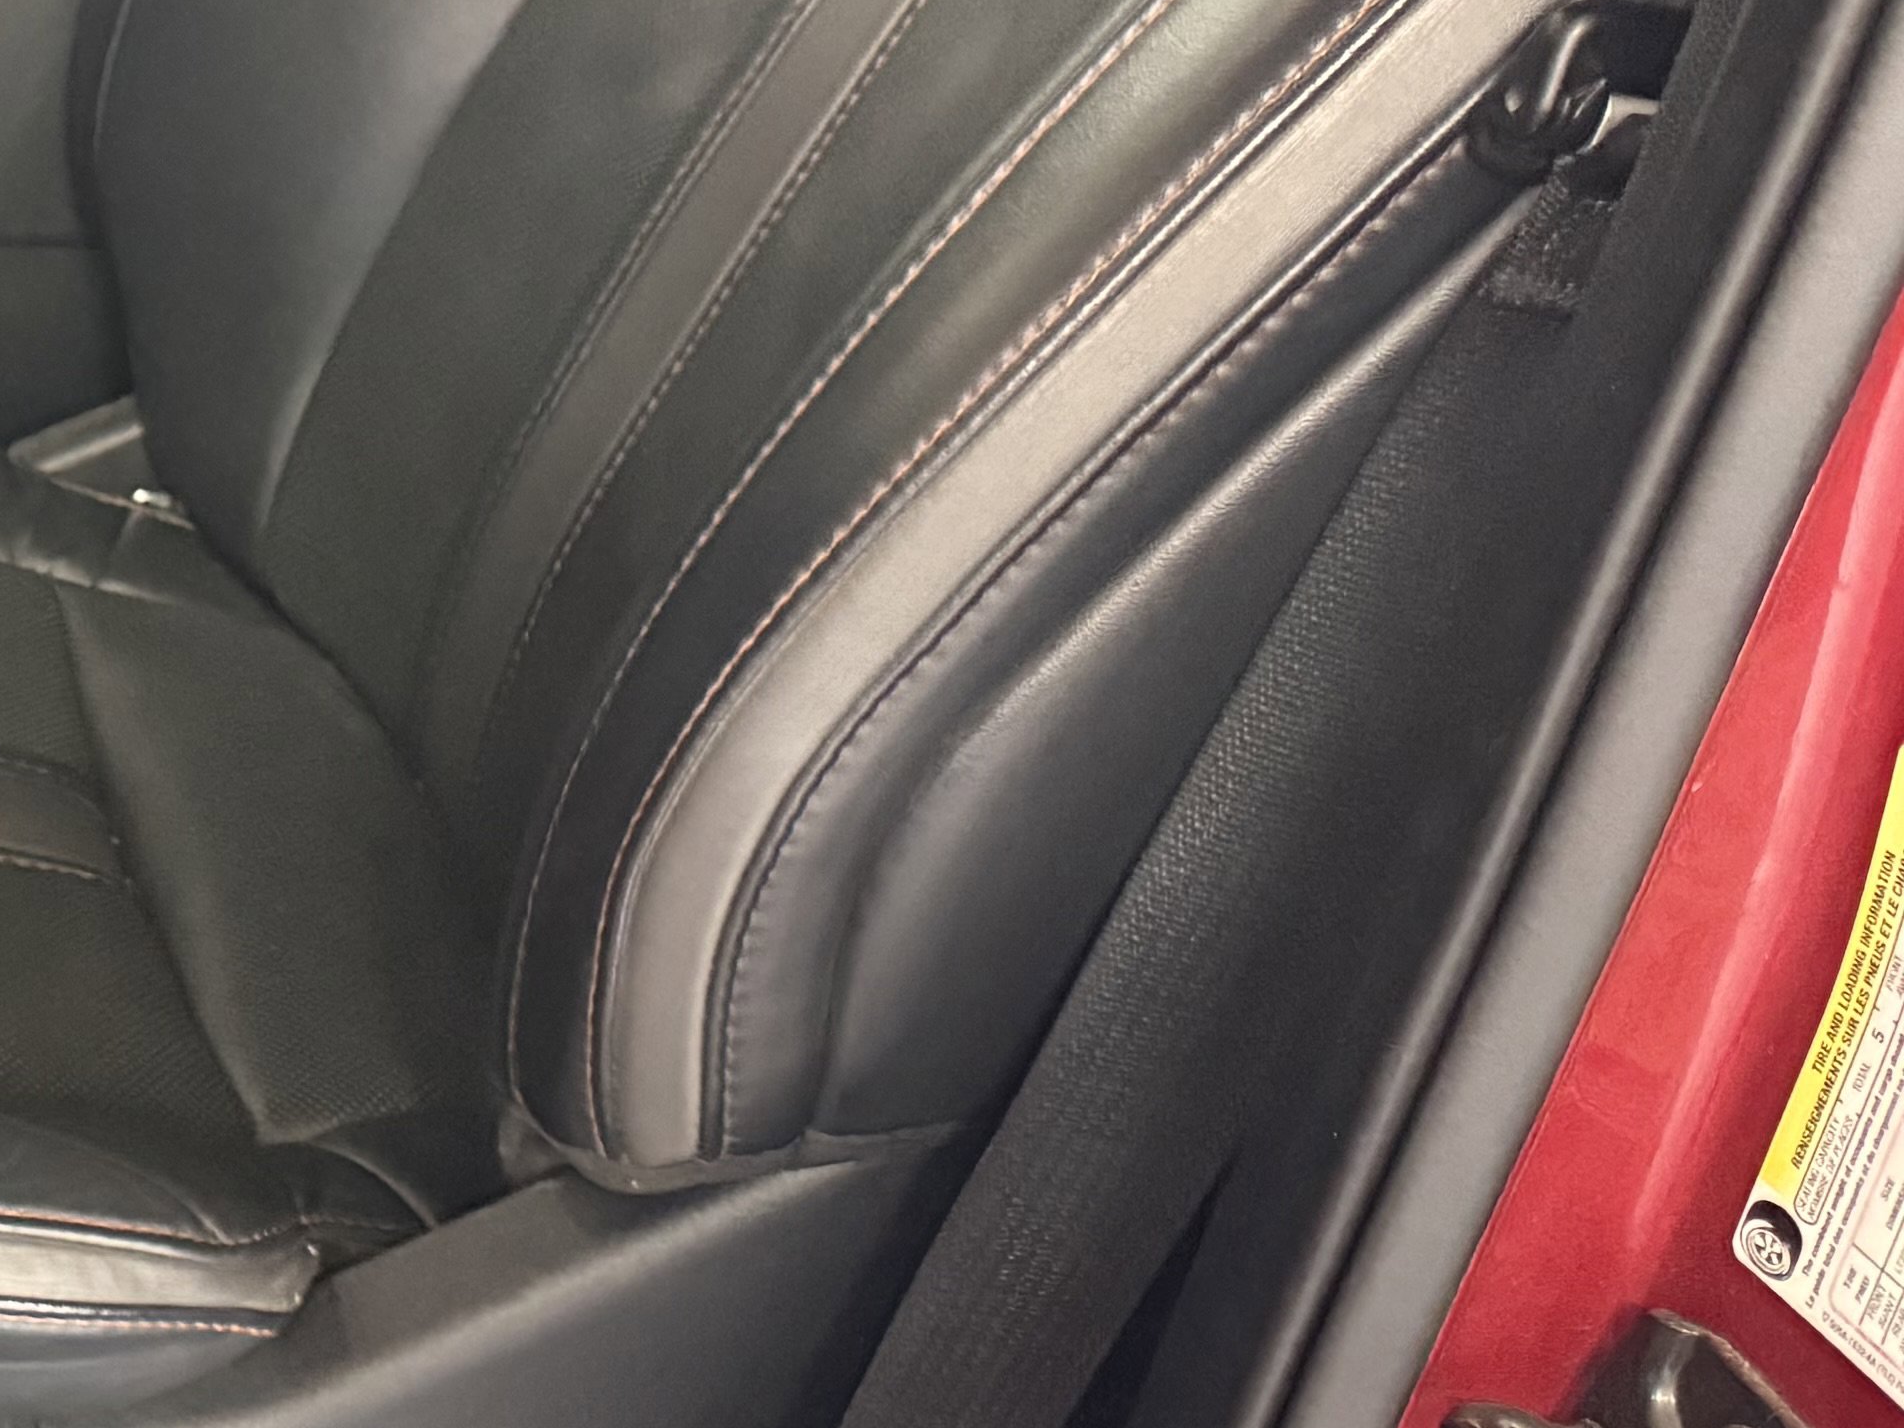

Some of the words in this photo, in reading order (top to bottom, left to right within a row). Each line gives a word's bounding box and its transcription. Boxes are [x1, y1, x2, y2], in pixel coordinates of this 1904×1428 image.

[1884, 897, 1899, 917] LE
[1878, 918, 1894, 939] ET
[1810, 1040, 1833, 1074] TIRE
[1822, 1010, 1845, 1043] AND
[1836, 948, 1868, 1011] LOADING
[1859, 848, 1896, 948] INFORMATION
[1862, 939, 1887, 987] PNEUS
[1851, 987, 1870, 1016] LES
[1839, 1016, 1860, 1047] SUR
[1851, 1061, 1872, 1092] TOTAL
[1869, 1028, 1887, 1044] 5
[1789, 1046, 1848, 1170] RENSEIGNEMENTS
